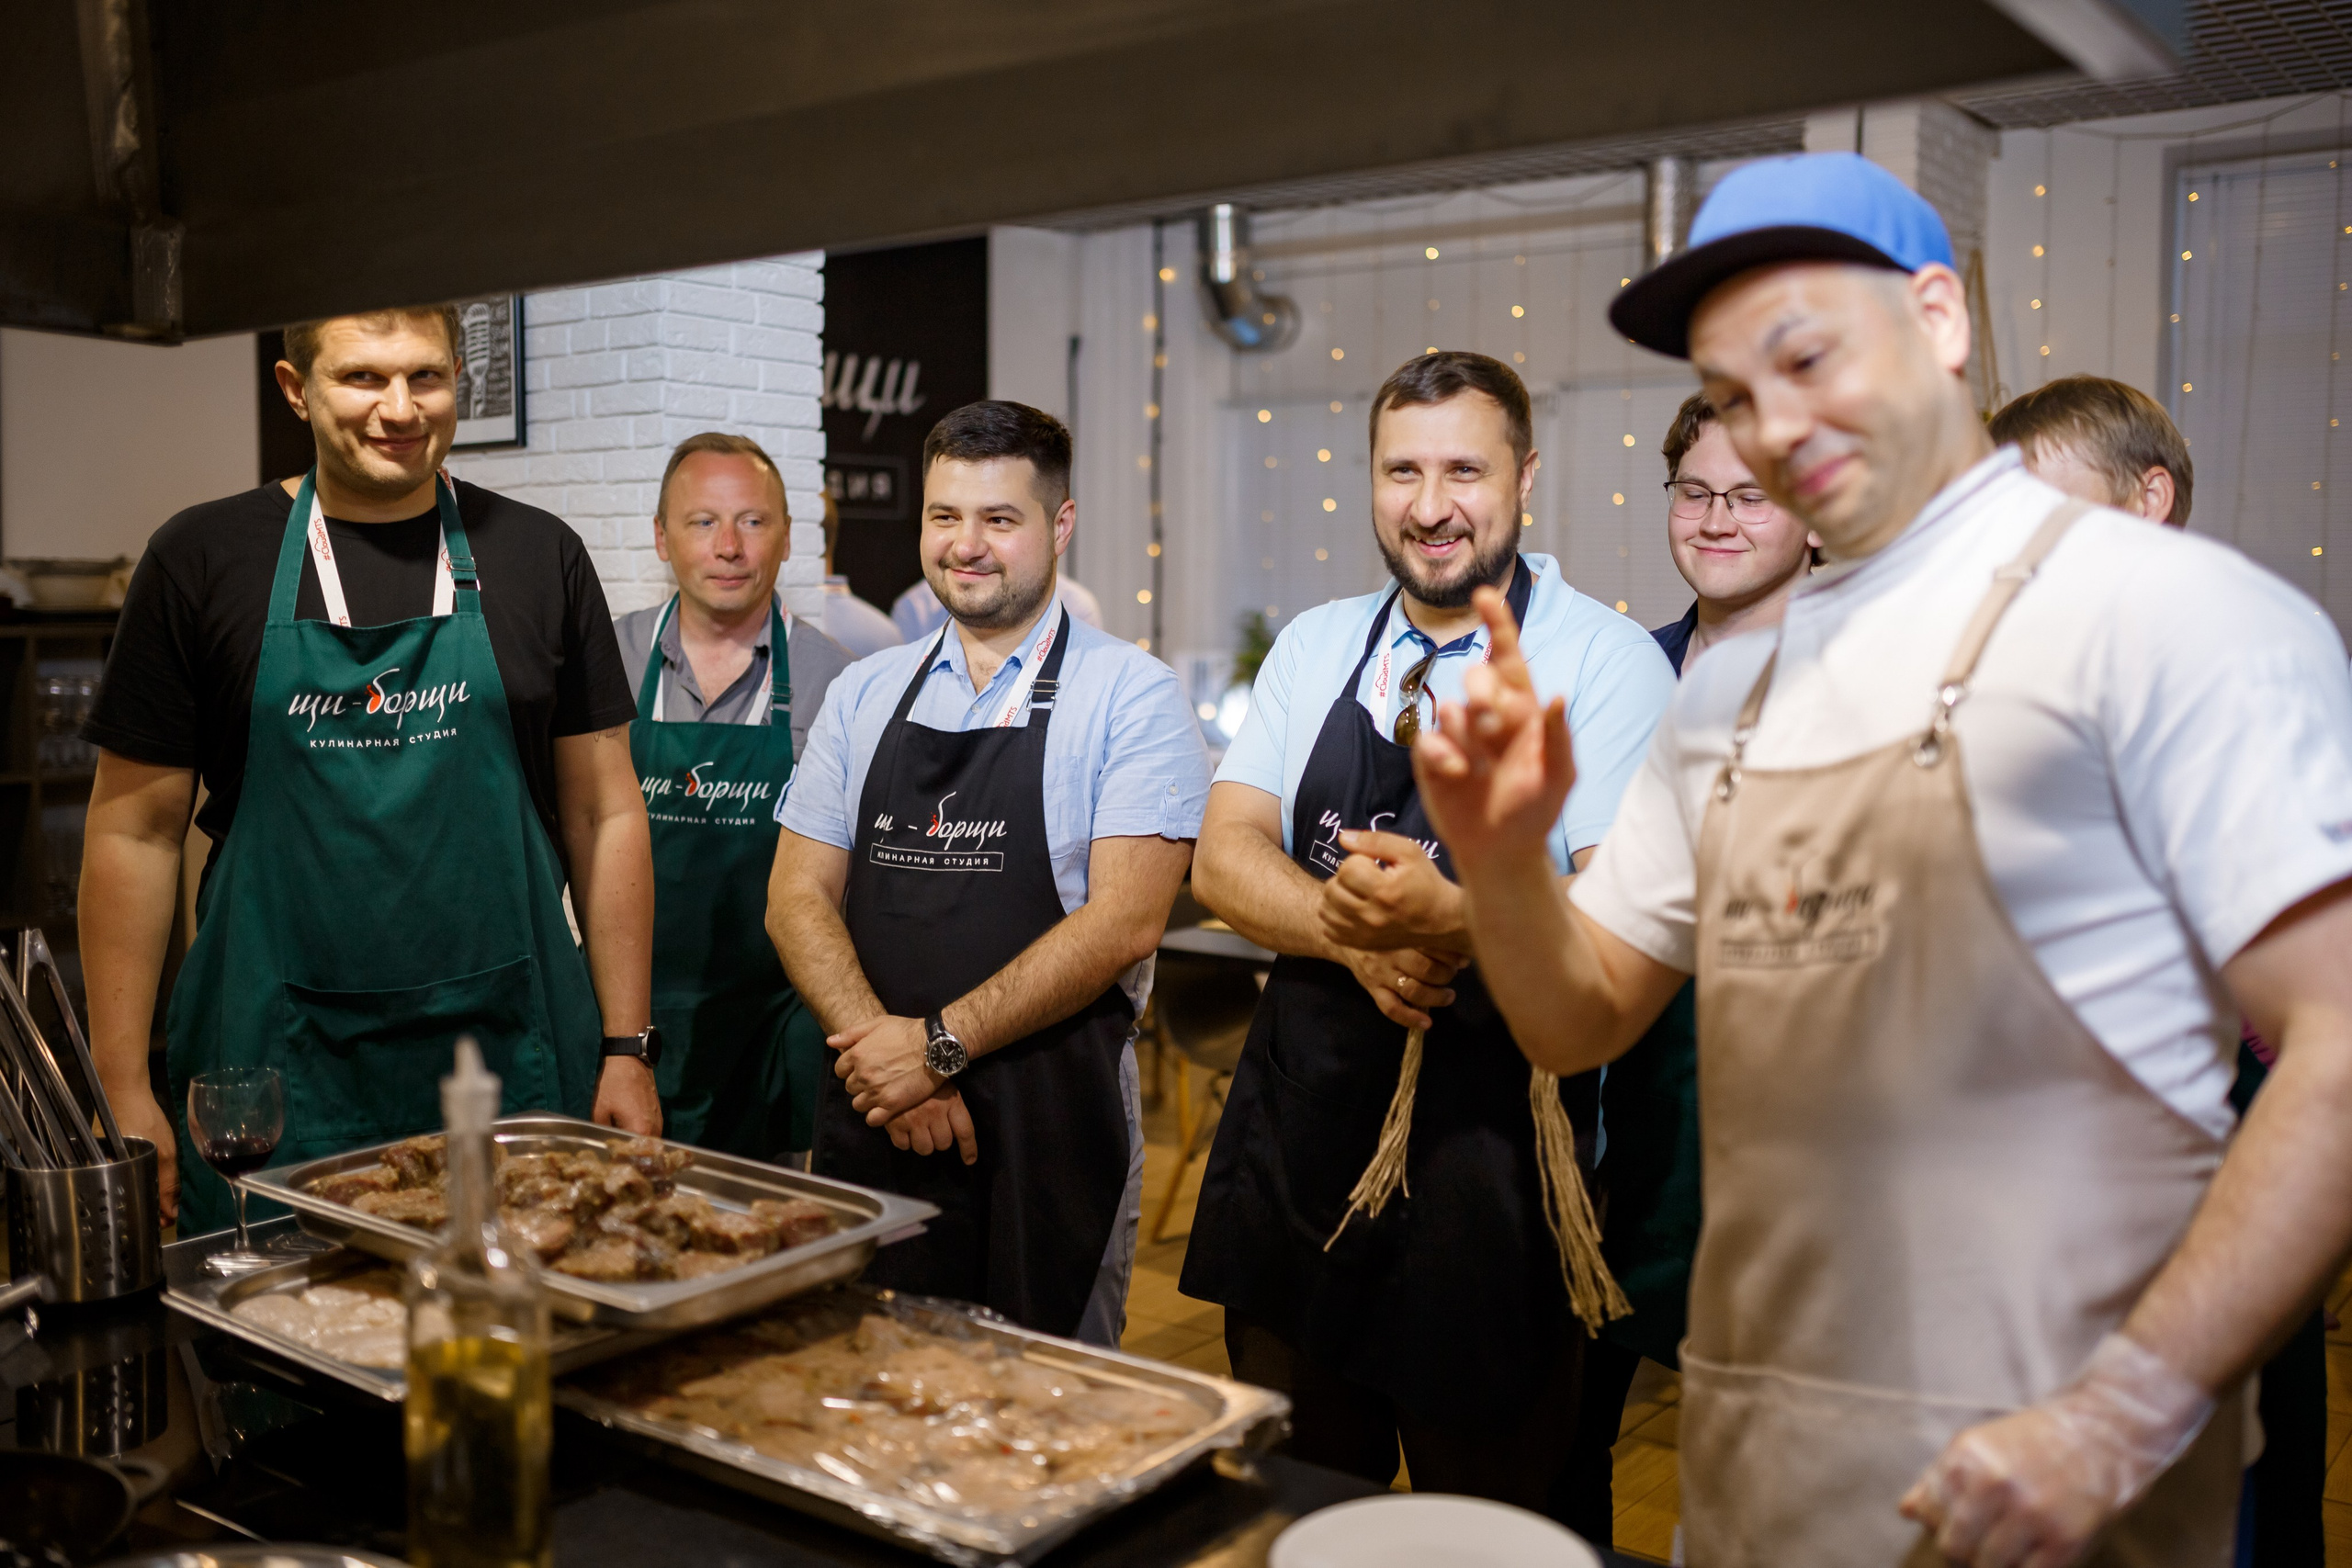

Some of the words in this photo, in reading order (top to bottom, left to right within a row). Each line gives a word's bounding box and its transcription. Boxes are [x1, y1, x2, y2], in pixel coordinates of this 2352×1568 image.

[1036, 627, 1056, 662] #CloudMTS
[1378, 653, 1390, 697] #CloudMTS
[310, 739, 400, 749] КУЛИНАРНАЯ
[409, 728, 458, 744] СТУДИЯ
[715, 818, 755, 826] СТУДИЯ
[944, 858, 989, 866] СТУДИЯ
